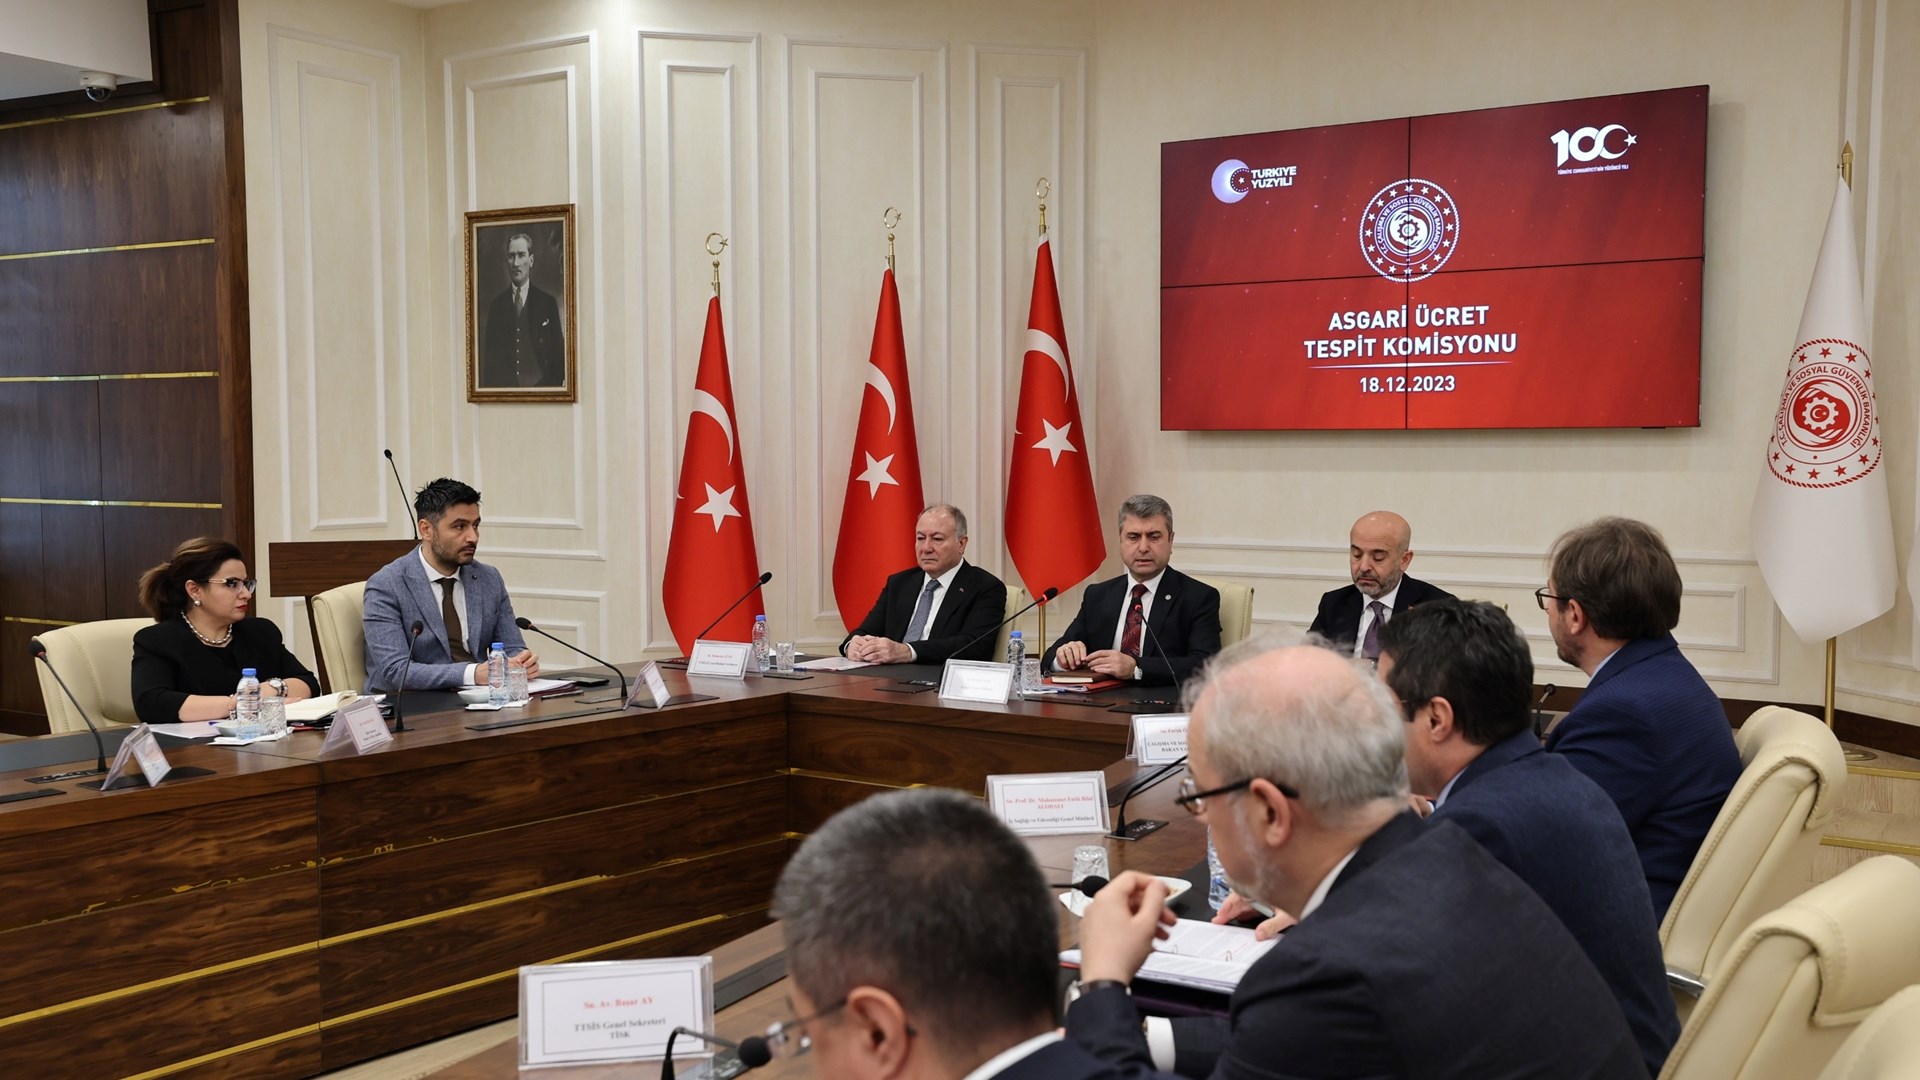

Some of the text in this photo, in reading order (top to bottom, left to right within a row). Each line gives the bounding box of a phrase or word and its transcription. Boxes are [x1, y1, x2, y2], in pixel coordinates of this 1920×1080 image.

[1383, 207, 1391, 217] VE
[1389, 197, 1413, 210] SOSYAL
[1328, 303, 1490, 331] ASGARİ ÜCRET
[1303, 331, 1517, 359] TESPİT KOMİSYONU
[1359, 375, 1456, 393] 18.12.2023
[1787, 380, 1796, 391] VE
[1795, 365, 1829, 383] SOSYAL
[1830, 366, 1870, 401] GÜVENLİK
[1850, 401, 1871, 449] BAKANLIĞI
[641, 995, 656, 1005] AY
[603, 1019, 628, 1030] Genel
[629, 1017, 667, 1028] Sekreteri
